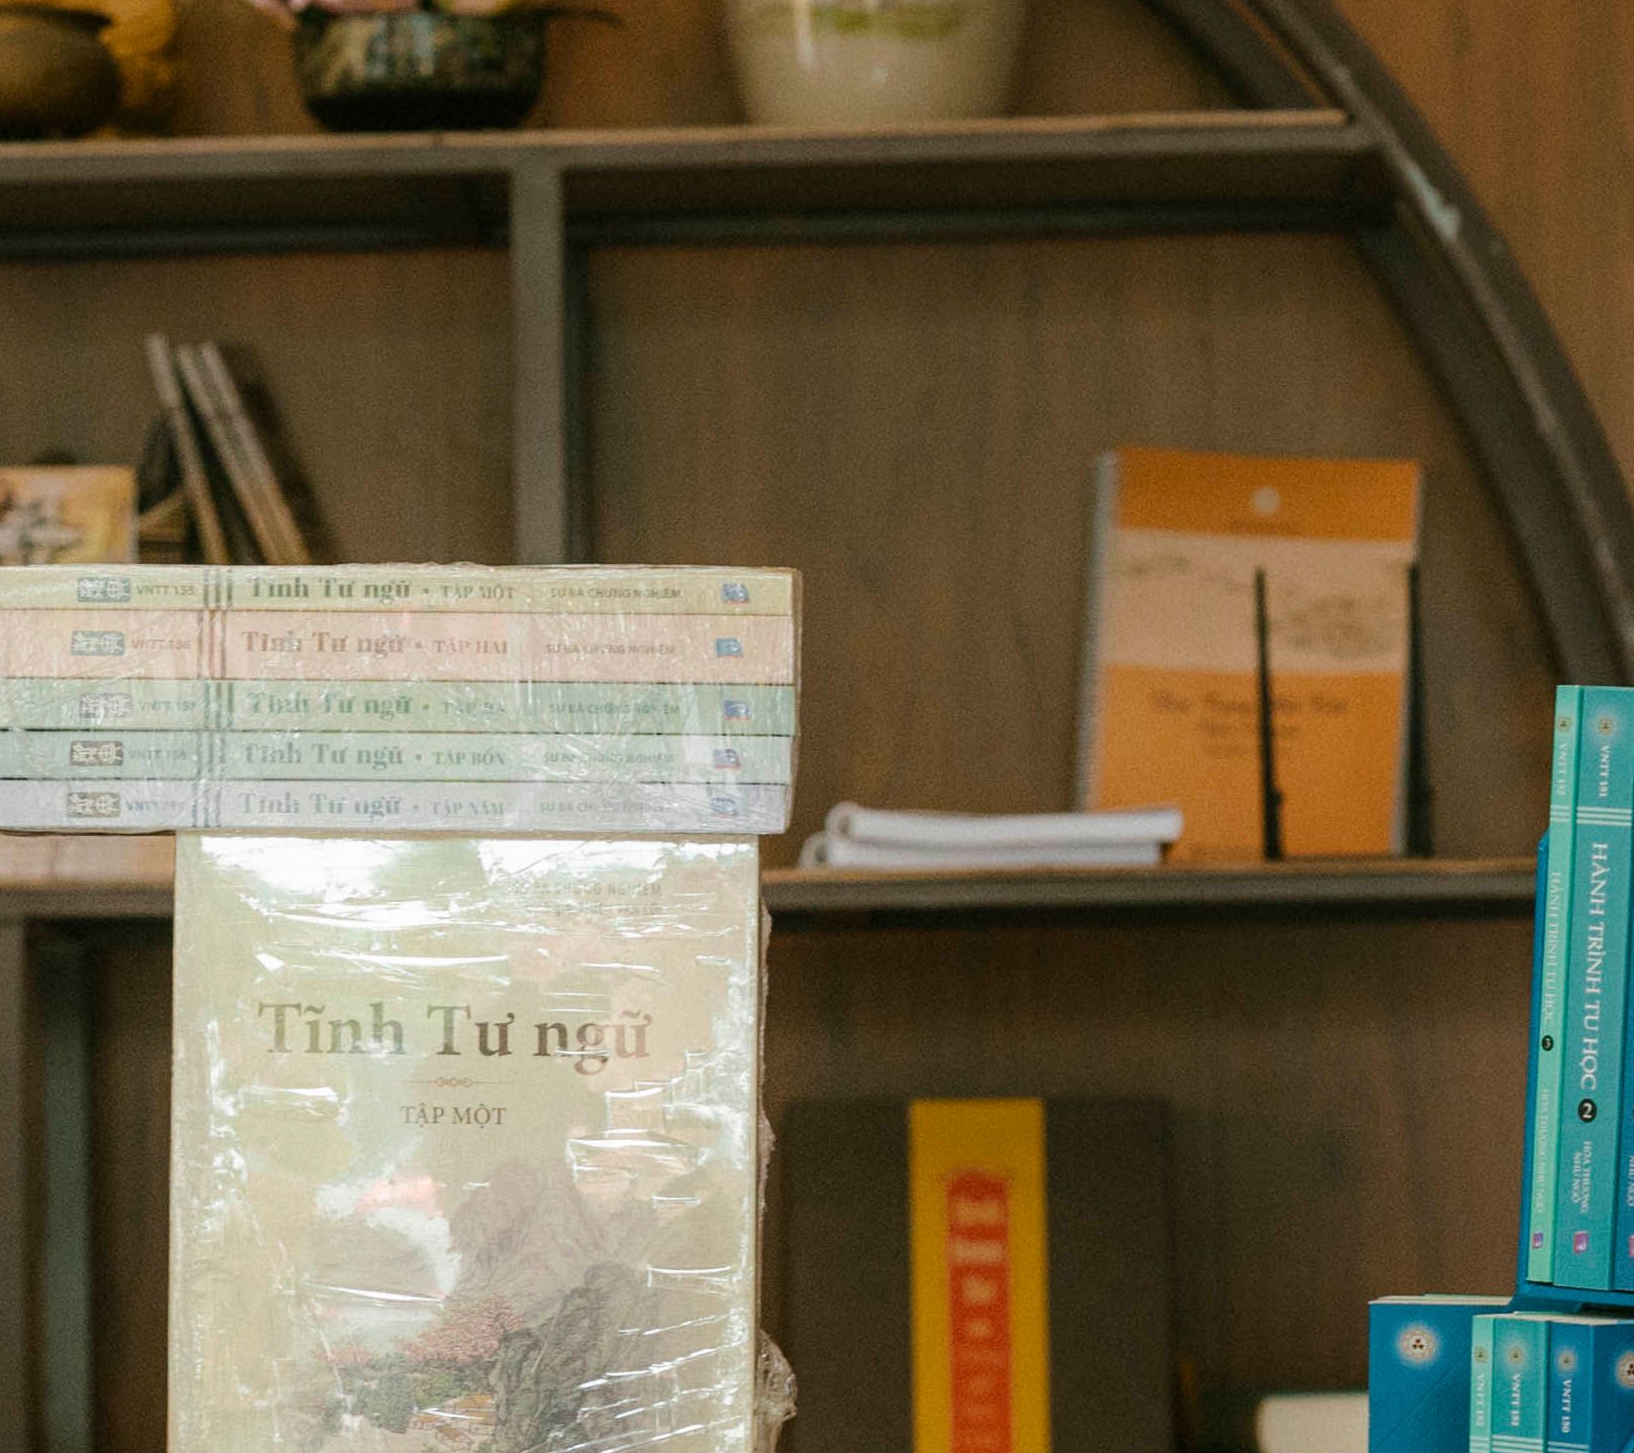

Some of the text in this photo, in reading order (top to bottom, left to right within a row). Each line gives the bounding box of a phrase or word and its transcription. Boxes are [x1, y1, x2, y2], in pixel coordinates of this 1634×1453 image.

[1577, 842, 1611, 1119] HÀNH TRÌNH TU HỌC 2
[257, 1001, 652, 1076] Tĩnh Tư ngữ
[399, 1102, 506, 1128] TẬP MỘT
